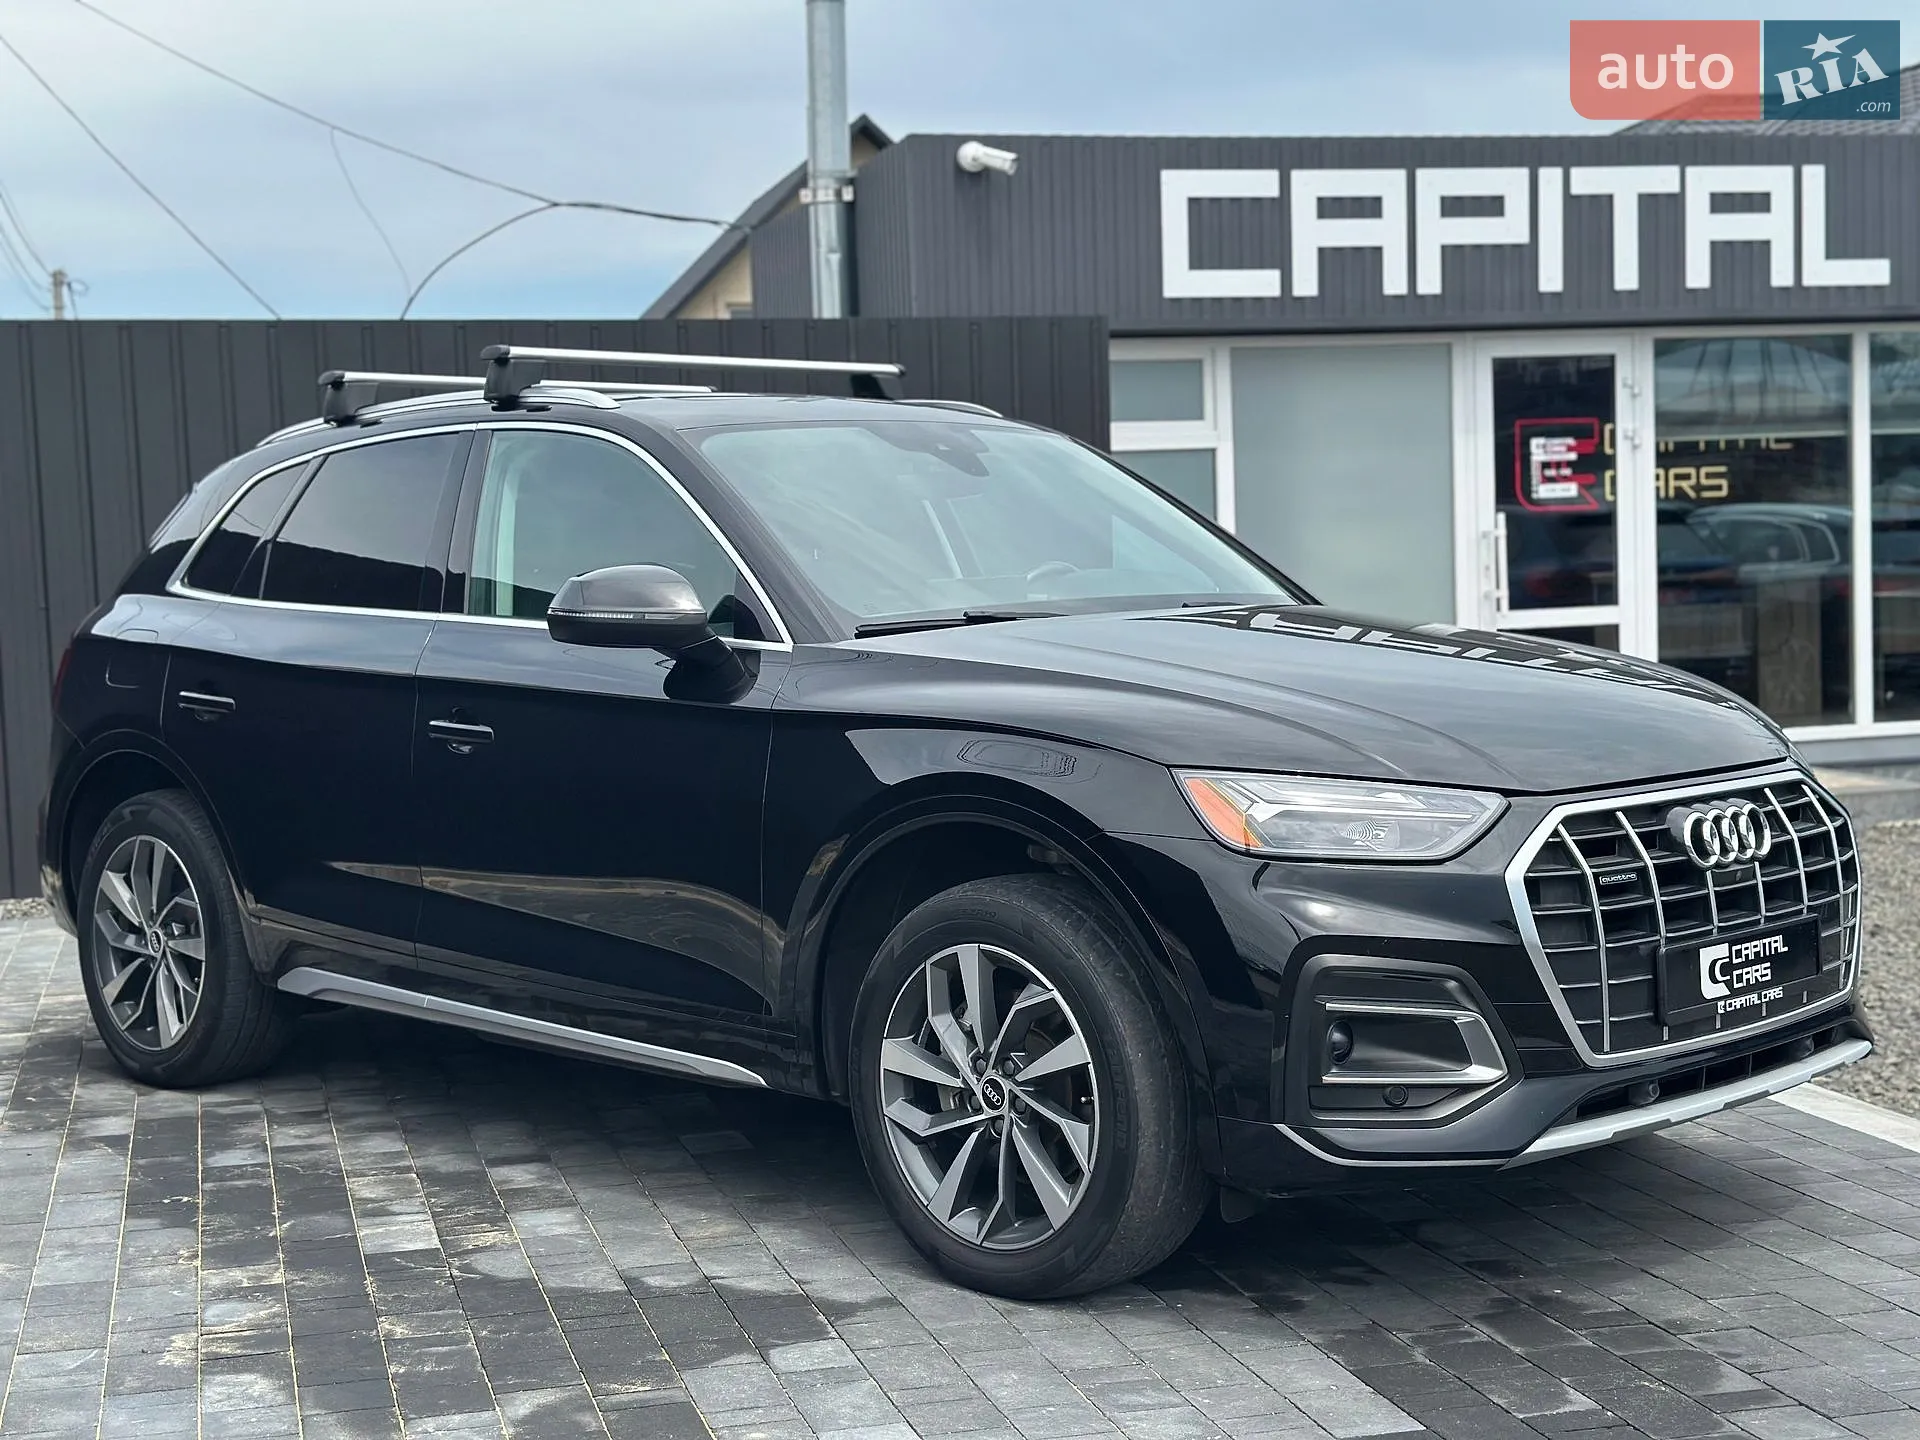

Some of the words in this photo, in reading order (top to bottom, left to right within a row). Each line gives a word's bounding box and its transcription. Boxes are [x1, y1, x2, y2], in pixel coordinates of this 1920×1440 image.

[1161, 165, 1890, 298] CAPITAL
[1602, 873, 1636, 884] quattro
[1731, 935, 1788, 964] CAPITAL
[1733, 962, 1771, 989] CARS
[1725, 994, 1762, 1012] CAPITAL
[1761, 987, 1783, 1005] CARS
